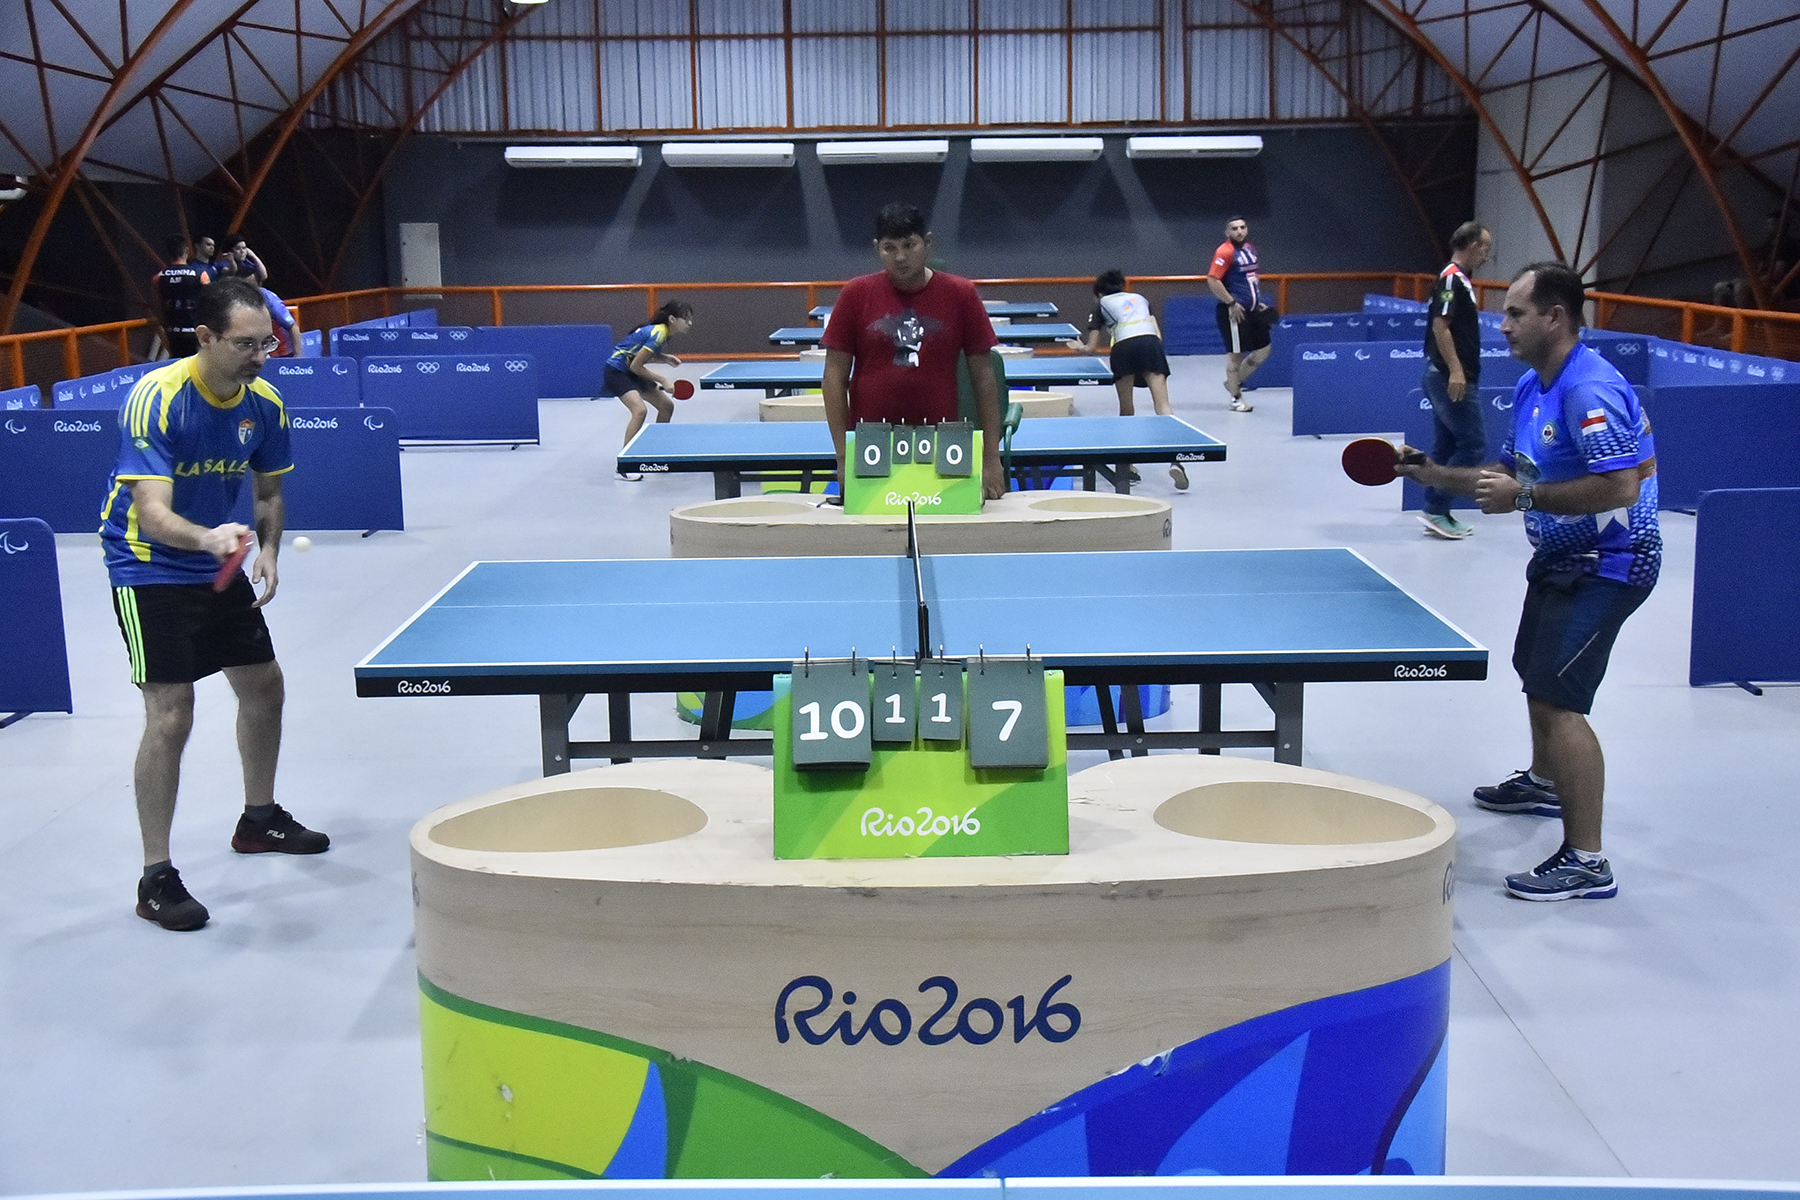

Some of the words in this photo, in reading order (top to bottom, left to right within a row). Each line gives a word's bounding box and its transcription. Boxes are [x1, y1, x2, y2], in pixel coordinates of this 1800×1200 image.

[279, 366, 314, 375] Rio2016
[368, 364, 402, 374] Rio2016
[456, 363, 490, 372] Rio2016
[53, 420, 102, 433] Rio2016
[292, 417, 339, 429] Rio2016
[864, 445, 881, 465] 0
[897, 440, 909, 456] 0
[919, 439, 931, 455] 0
[946, 444, 963, 465] 0
[885, 491, 942, 505] Rio2016
[1394, 664, 1448, 678] Rio2016
[397, 680, 452, 694] Rio2016
[799, 700, 865, 741] 10
[885, 693, 906, 724] 1
[931, 692, 952, 723] 1
[991, 700, 1023, 742] 7
[860, 807, 981, 837] Rio2016
[266, 829, 286, 839] FILA
[775, 974, 1082, 1046] Rio2016
